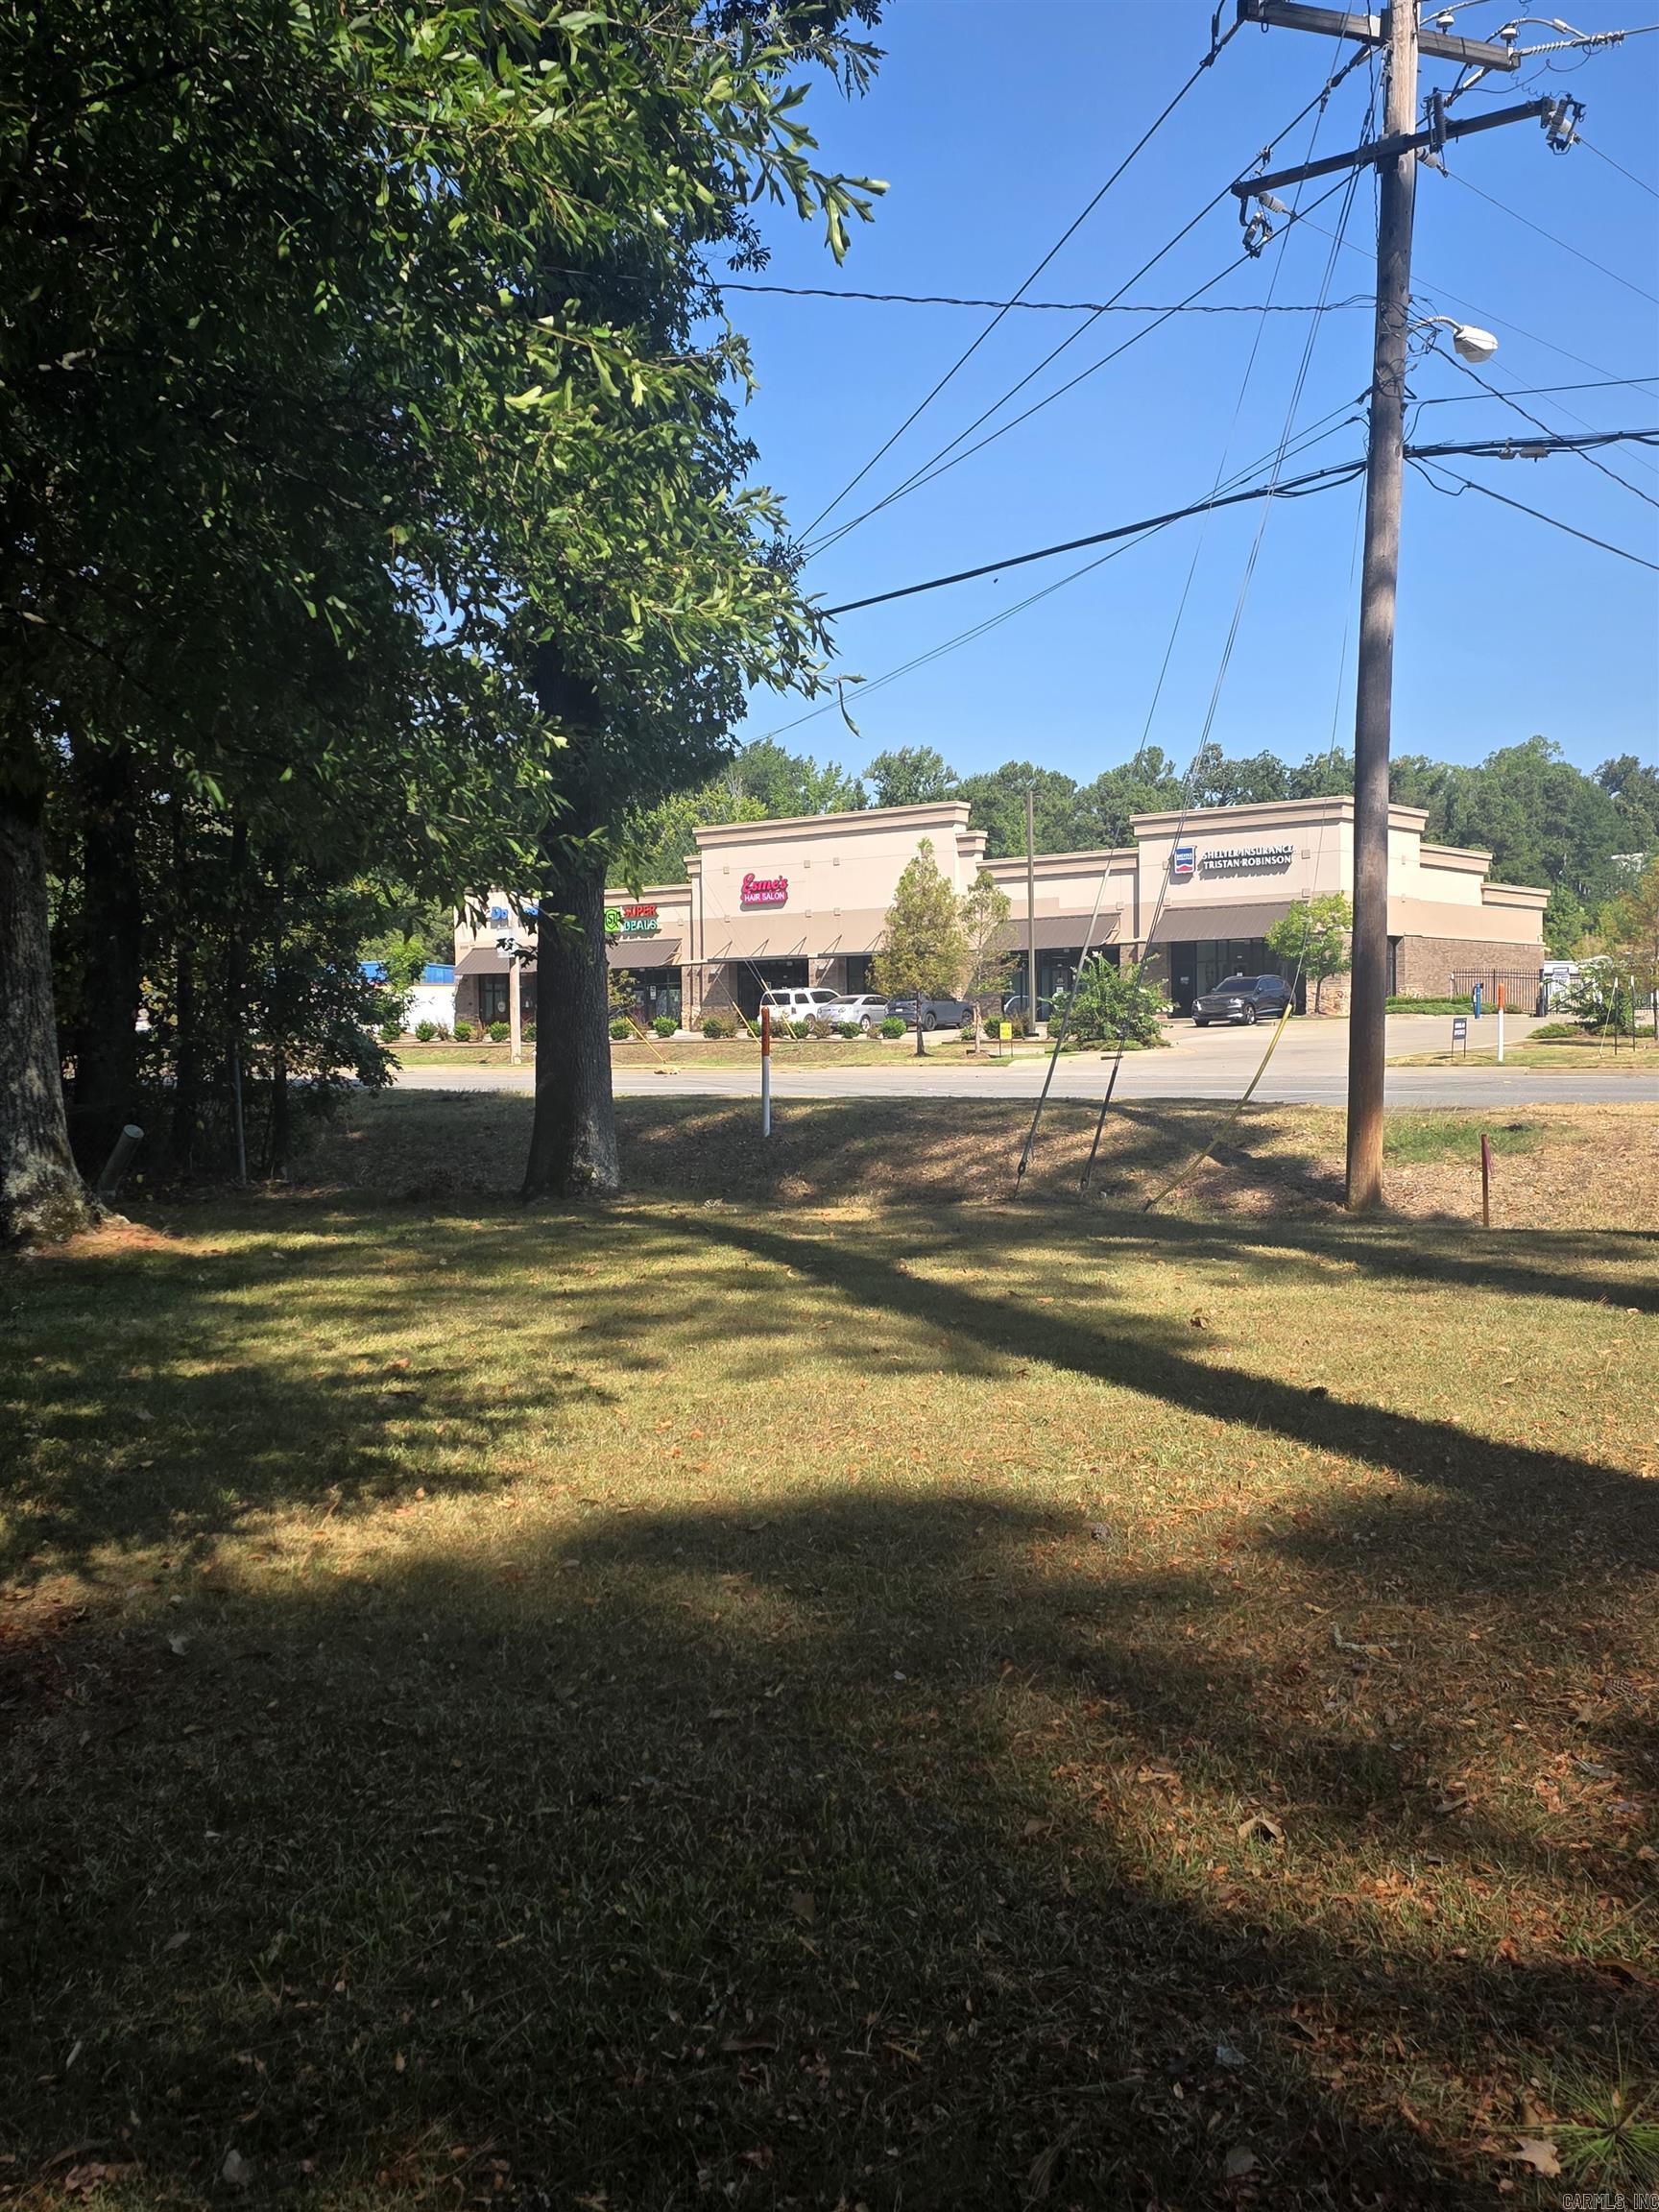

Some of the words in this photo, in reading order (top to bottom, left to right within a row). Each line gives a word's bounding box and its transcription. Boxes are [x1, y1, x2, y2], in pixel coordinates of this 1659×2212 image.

[1202, 850, 1239, 859] SHELTER
[1239, 844, 1294, 855] INSURANCE
[1204, 858, 1239, 870] TRISTAN
[1241, 855, 1291, 867] ROBINSON
[744, 893, 760, 902] HAIR
[762, 892, 784, 901] SALON
[624, 905, 658, 918] SUPER
[624, 918, 658, 931] DEALS
